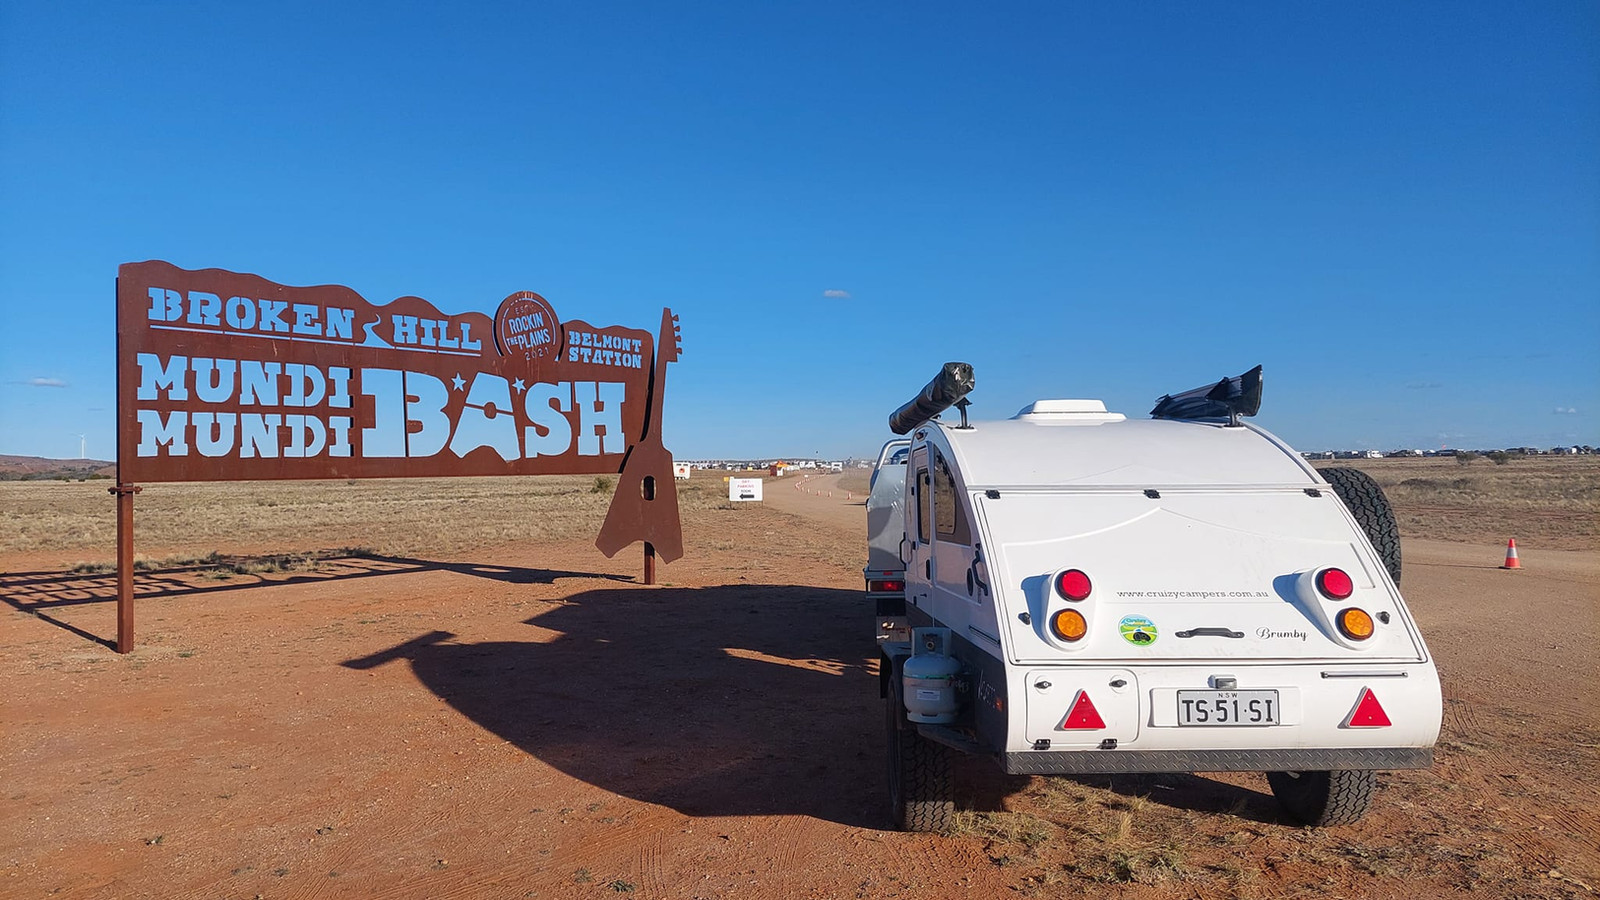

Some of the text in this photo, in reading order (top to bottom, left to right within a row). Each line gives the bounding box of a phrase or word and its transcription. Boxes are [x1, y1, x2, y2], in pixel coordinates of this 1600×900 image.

[148, 287, 482, 351] BROKEN HILL
[508, 312, 544, 335] ROCKIN
[506, 328, 551, 350] THE PLAINS
[568, 330, 642, 353] BELMONT
[525, 346, 550, 361] 2021
[568, 346, 642, 368] STATION
[137, 353, 351, 408] MUNDI
[361, 367, 625, 462] BASH
[137, 409, 351, 458] MUNDI
[1116, 589, 1270, 600] www.cruizycampers.com.au
[1255, 626, 1309, 642] Brumby
